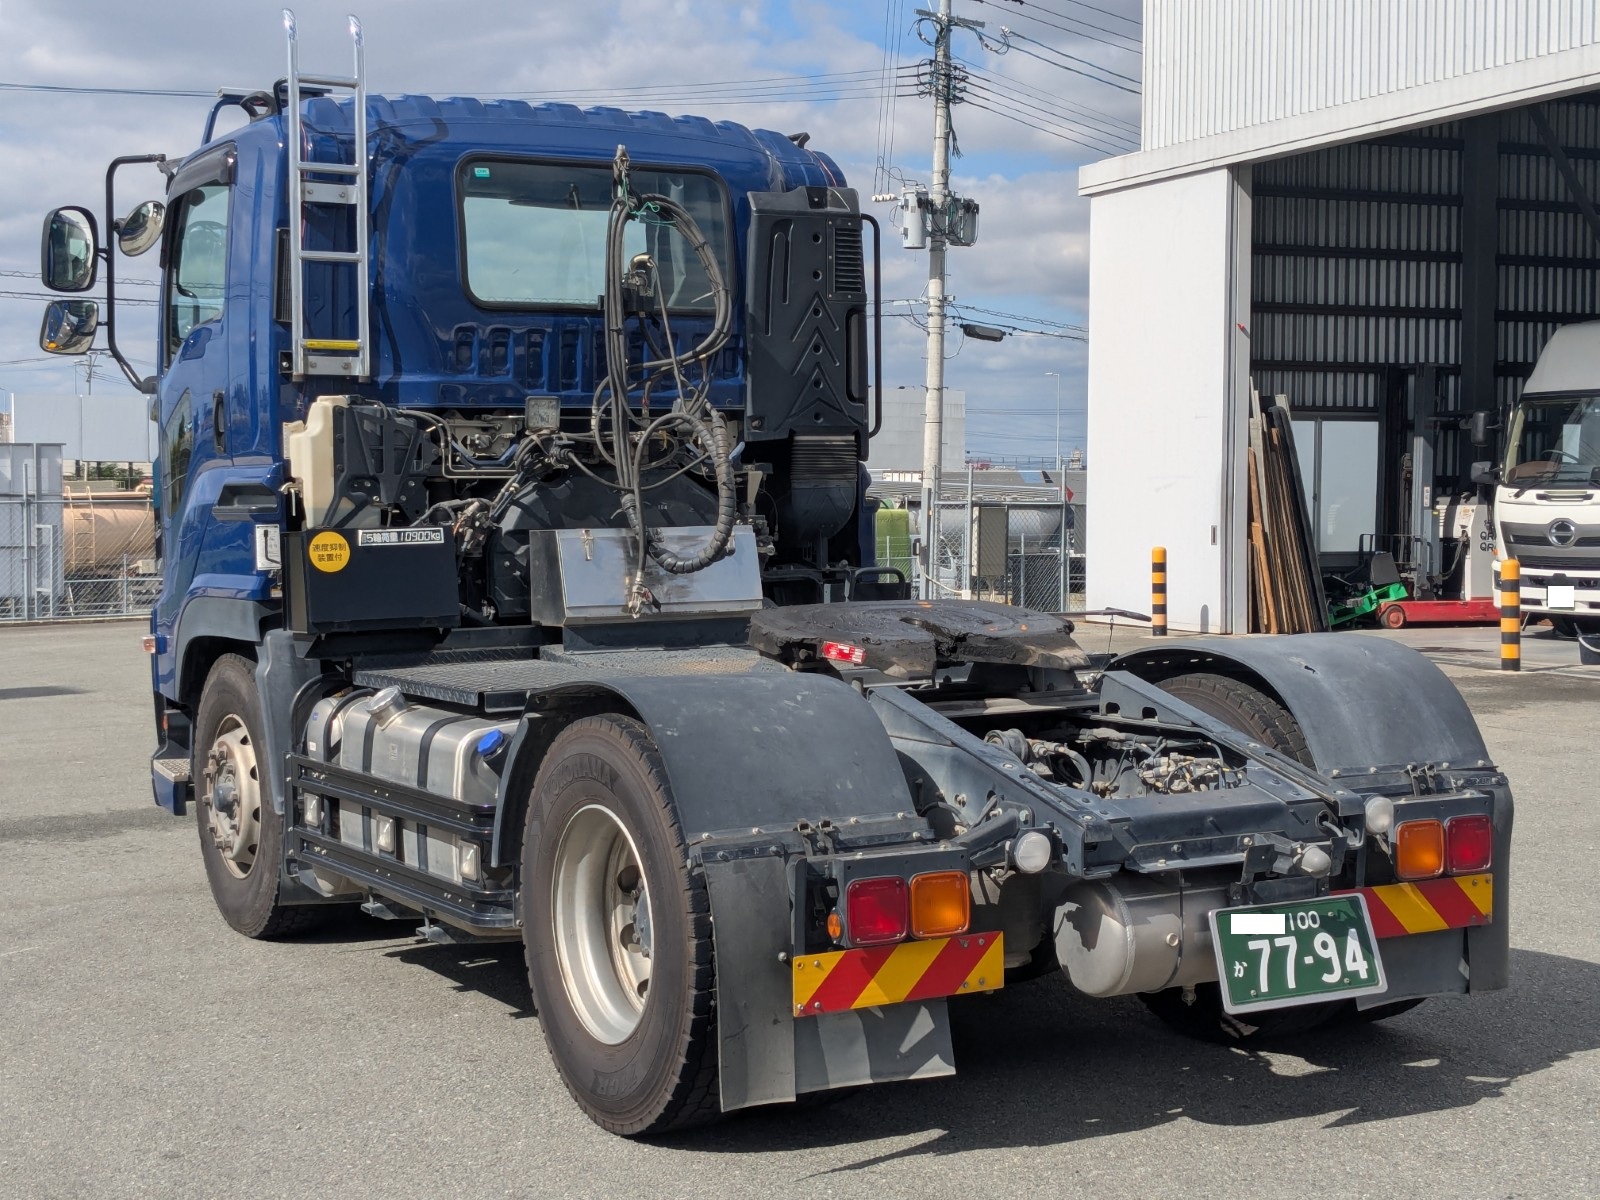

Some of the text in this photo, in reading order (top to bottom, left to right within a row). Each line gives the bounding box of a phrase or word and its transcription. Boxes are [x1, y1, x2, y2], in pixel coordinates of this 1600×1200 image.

[401, 531, 441, 541] 10900kg
[1480, 531, 1497, 541] QR
[312, 543, 346, 552] 速度抑制
[317, 553, 343, 562] 装置付
[1288, 911, 1320, 931] 100
[1233, 928, 1368, 993] か 77-94
